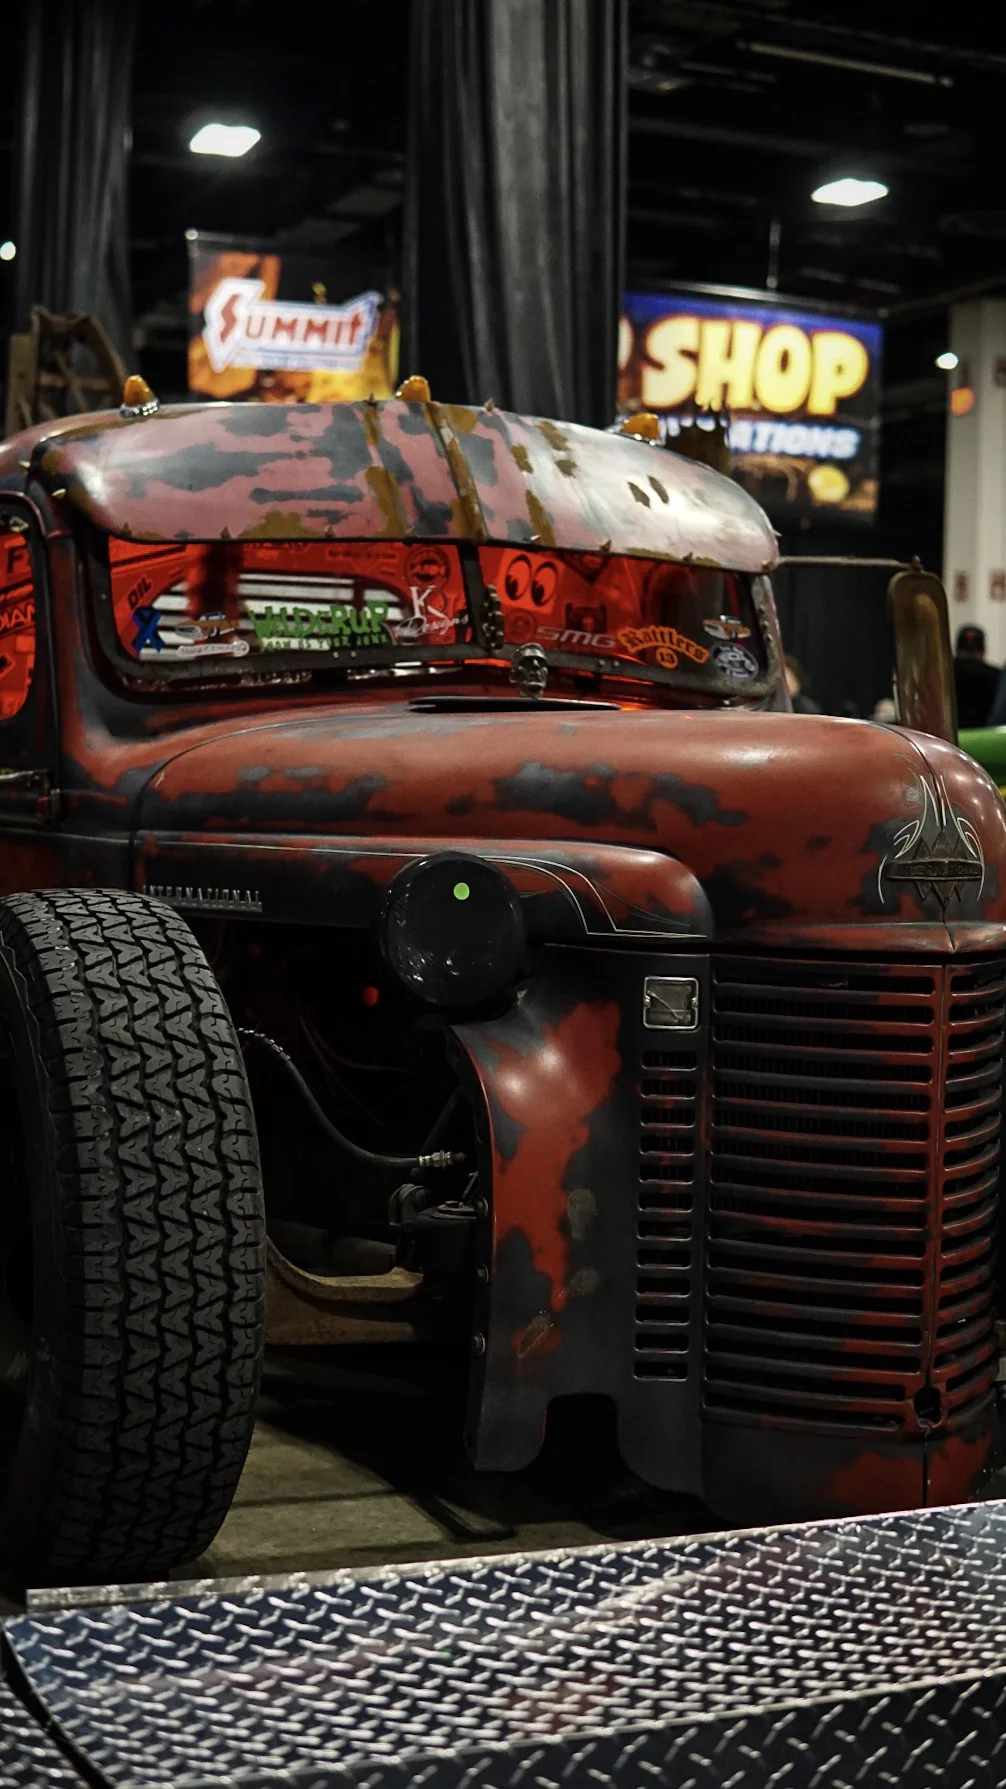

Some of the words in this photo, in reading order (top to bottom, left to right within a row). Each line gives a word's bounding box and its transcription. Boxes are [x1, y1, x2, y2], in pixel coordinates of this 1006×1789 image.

[641, 313, 870, 416] SHOP
[618, 627, 707, 662] Rattlers
[659, 651, 675, 664] 13
